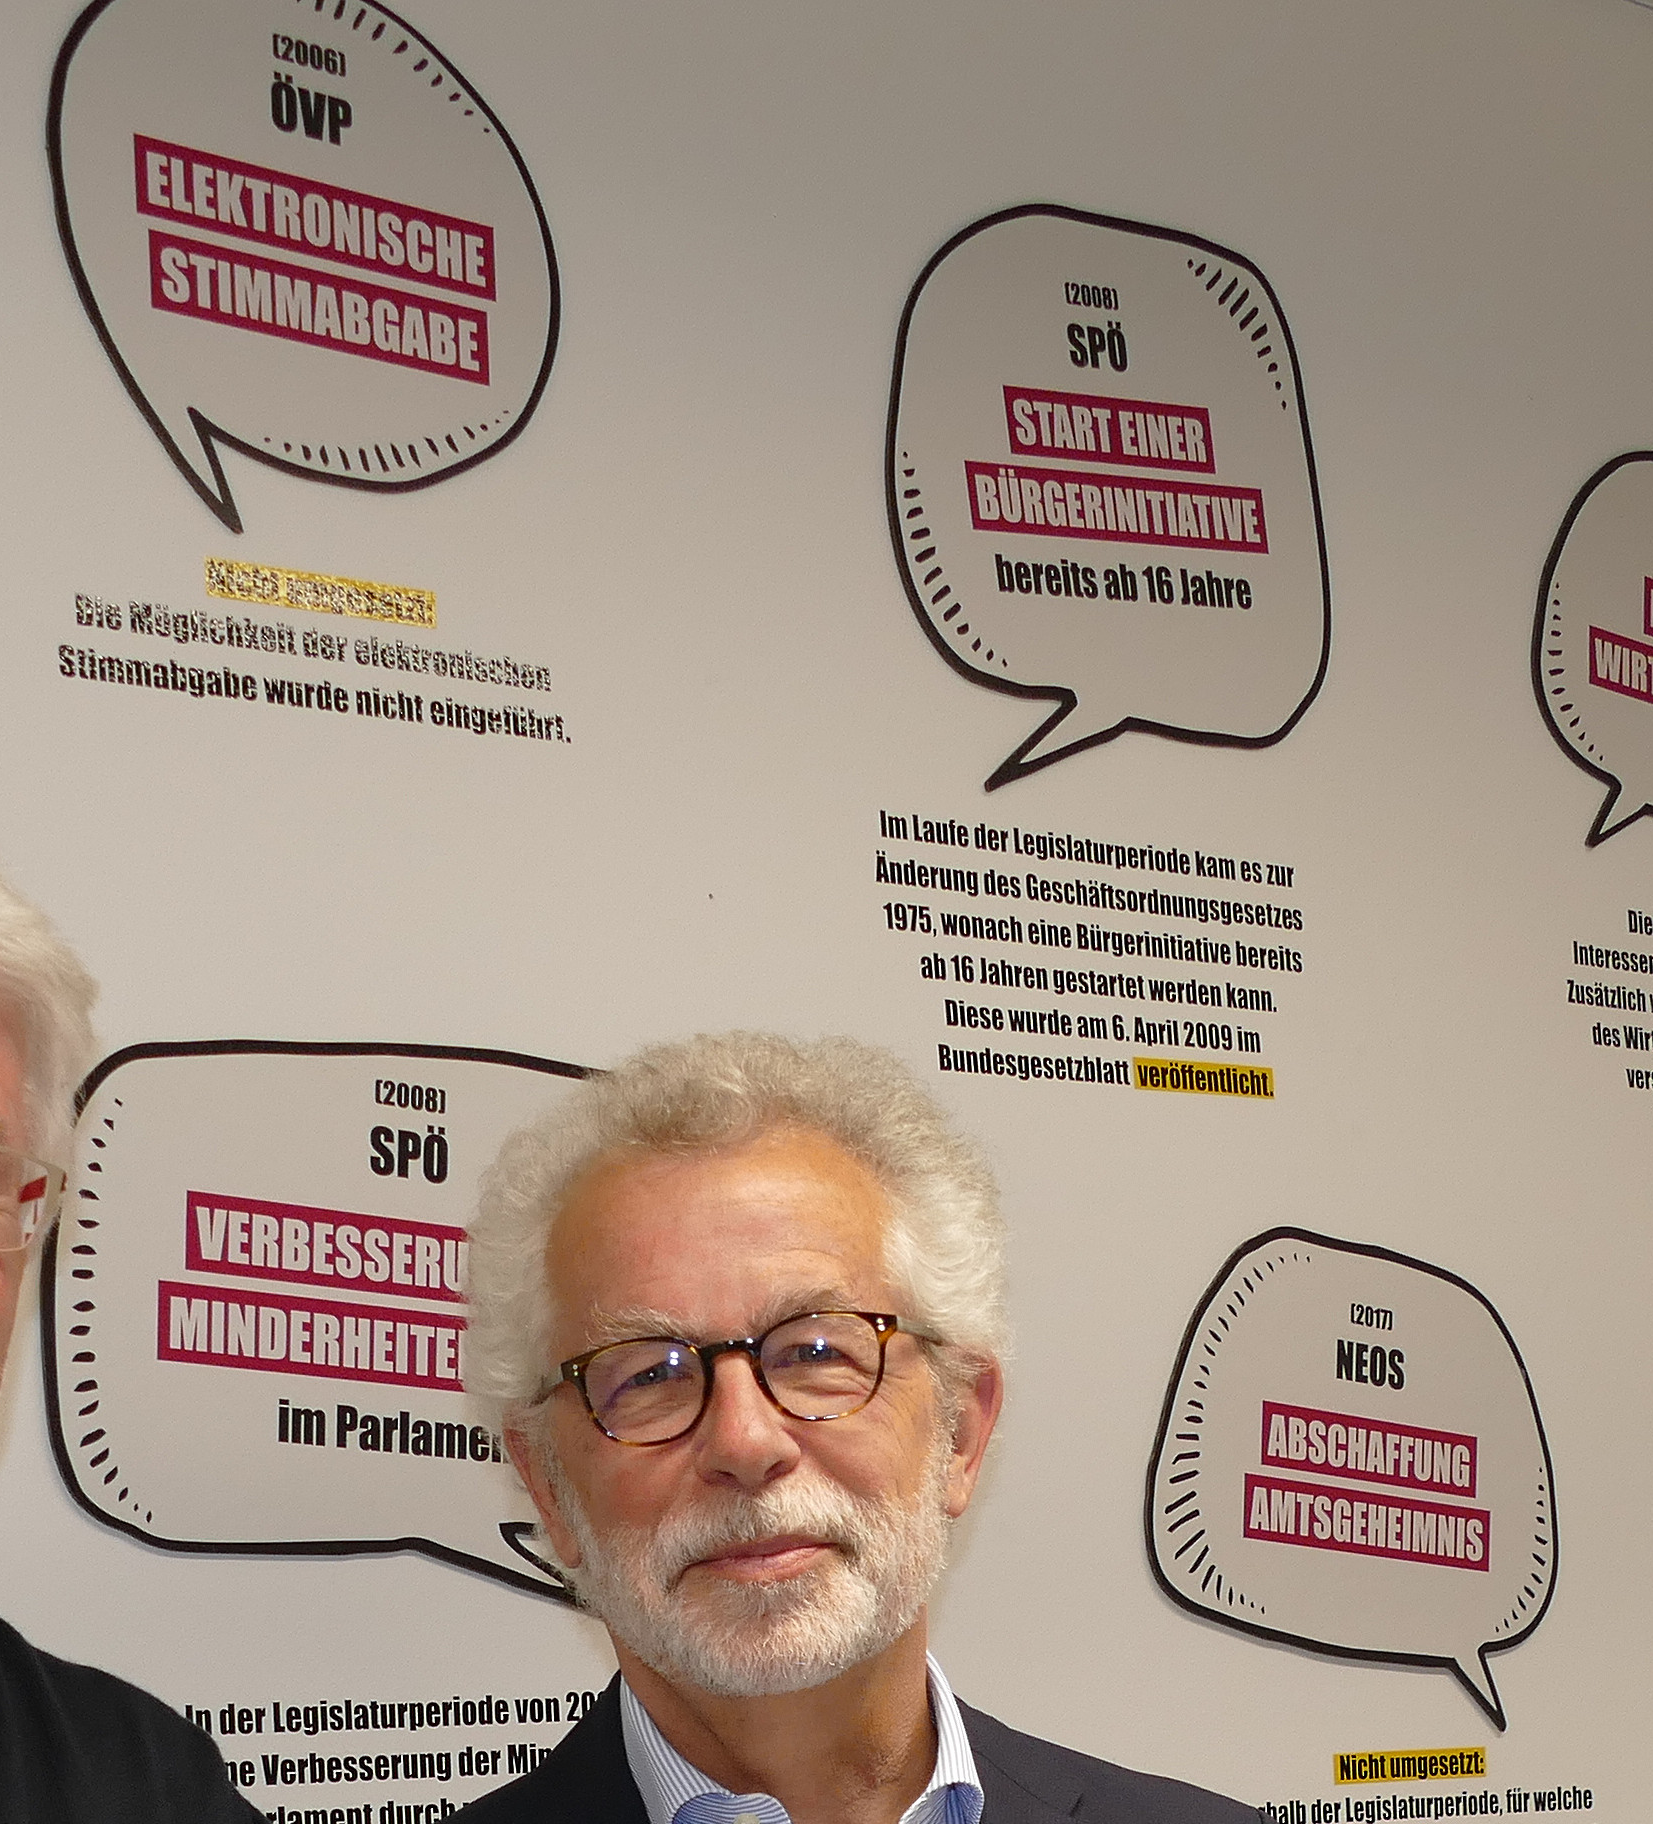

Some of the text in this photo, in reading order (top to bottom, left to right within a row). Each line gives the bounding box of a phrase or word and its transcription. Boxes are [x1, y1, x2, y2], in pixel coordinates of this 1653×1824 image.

[271, 71, 352, 145] ÖVP
[147, 151, 486, 287] ELEKTRONISCHE
[161, 248, 479, 372] STIMMABGABE
[1067, 320, 1127, 372] SPÖ
[1013, 399, 1212, 462] START EINER
[975, 471, 1265, 543] BÜRGERINITIATIVE
[995, 554, 1252, 609] bereits ab 16 Jahre
[59, 645, 571, 744] Stimmabgabe wurde nicht eingeführt.
[880, 810, 1294, 887] Im Laufe der Legislaturperiode kam es zur
[876, 850, 1302, 930] Änderung des Geschäftsordnungsgesetzes
[1628, 910, 1653, 935] Die
[921, 953, 1277, 1012] ab 16 Jahren gestartet werden kann.
[945, 999, 1260, 1053] Diese wurde am 6. April 2009 im
[1593, 1022, 1620, 1047] des
[938, 1044, 1273, 1096] Bundesgesetzblatt veröffentlicht.
[370, 1125, 448, 1183] SPÖ
[169, 1296, 463, 1380] MINDERHEITE
[1337, 1339, 1404, 1390] NEOS
[279, 1399, 325, 1446] im
[1268, 1414, 1470, 1487] ABSCHAFFUNG
[1250, 1486, 1483, 1561] AMTSGEHEIMNIS
[220, 1695, 560, 1735] der Legislaturperiode von
[261, 1746, 501, 1785] Verbesserung der
[1340, 1752, 1484, 1780] Nicht umgesetzt:
[1311, 1786, 1592, 1824] der Legislaturperiode, für welche
